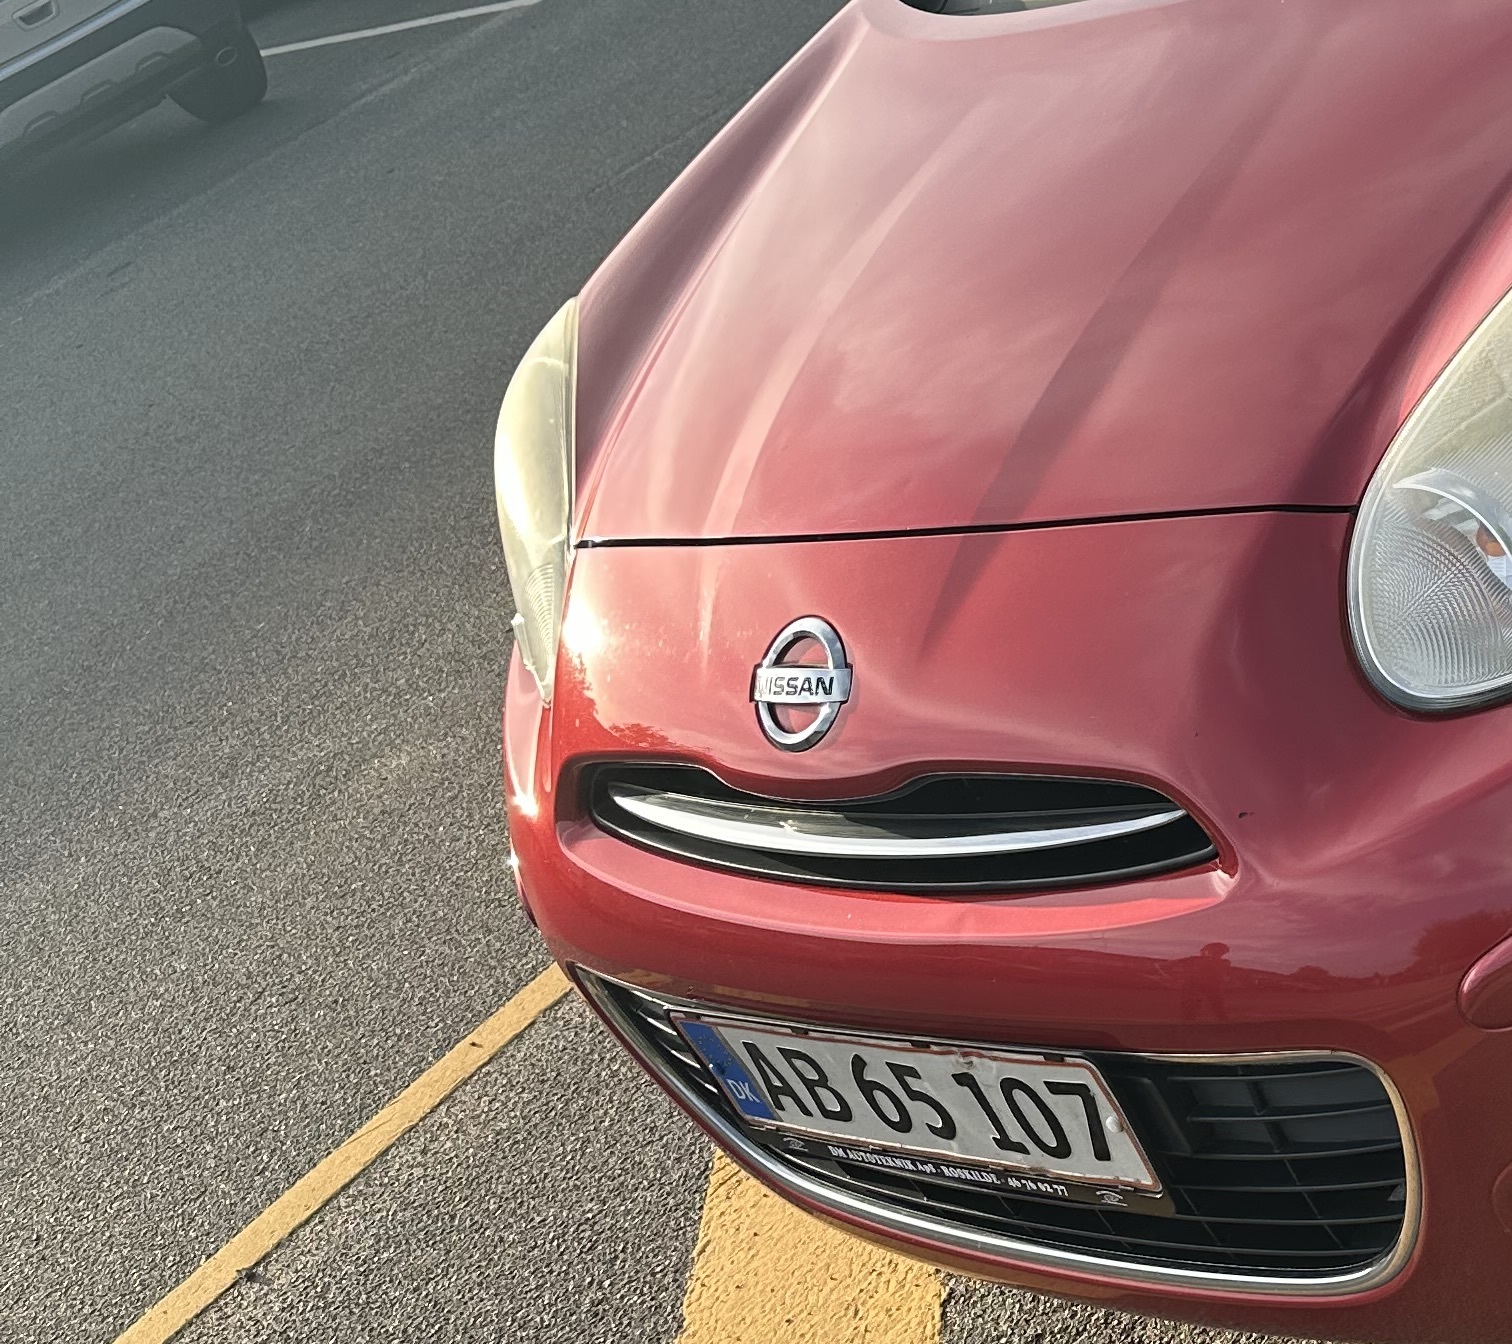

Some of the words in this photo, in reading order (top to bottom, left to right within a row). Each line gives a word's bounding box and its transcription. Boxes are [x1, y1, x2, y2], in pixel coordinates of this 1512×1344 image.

[758, 676, 834, 698] NISSAN
[725, 1077, 760, 1105] DK
[741, 1040, 853, 1123] AB
[851, 1054, 956, 1140] 65
[952, 1072, 1112, 1162] 107
[846, 1150, 918, 1171] AUTOTEKNIK
[940, 1165, 1001, 1185] ROSKILDE
[1052, 1184, 1069, 1197] 77
